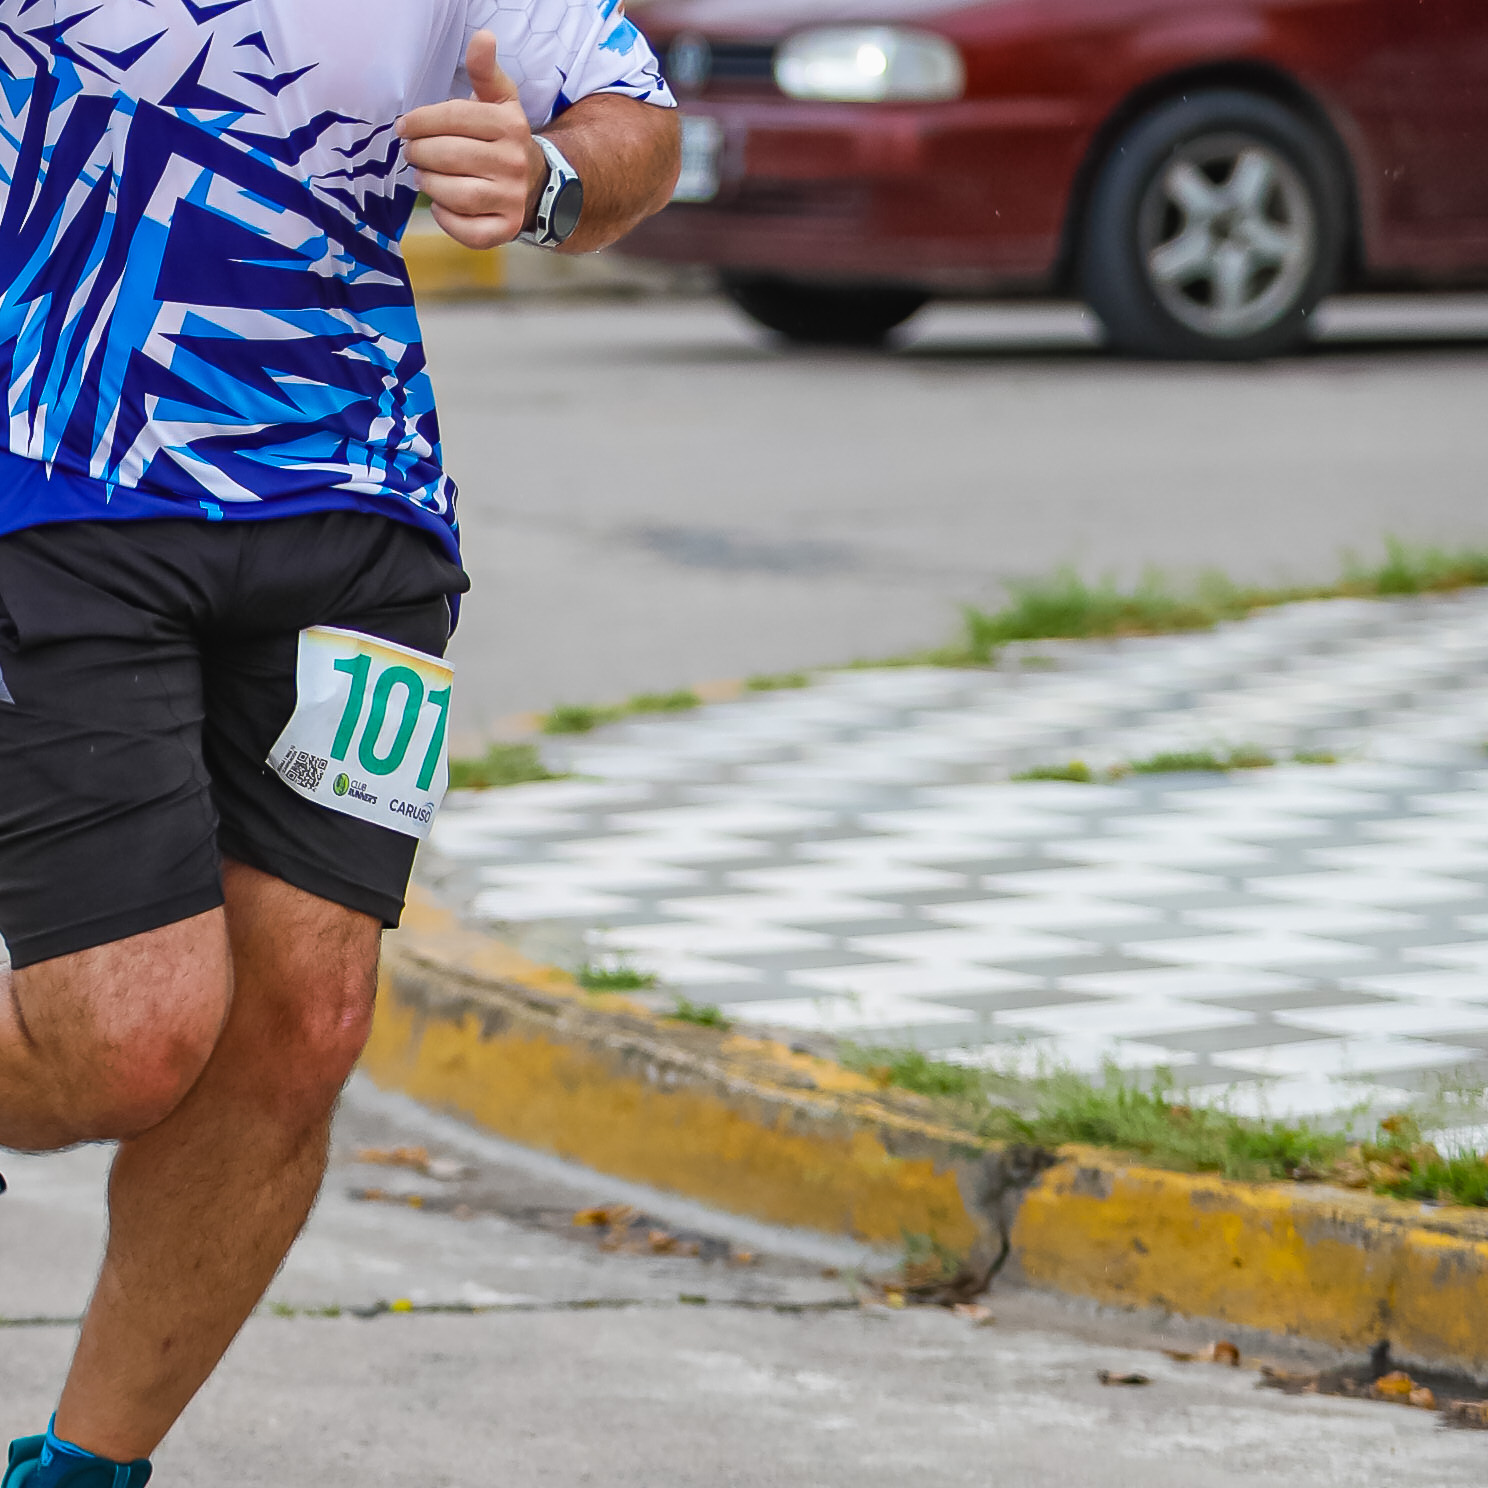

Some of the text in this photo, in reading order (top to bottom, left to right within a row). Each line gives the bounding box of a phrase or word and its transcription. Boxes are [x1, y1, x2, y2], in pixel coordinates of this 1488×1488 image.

[330, 653, 451, 792] 101
[350, 780, 367, 791] CLUB
[389, 798, 431, 823] CARUSO
